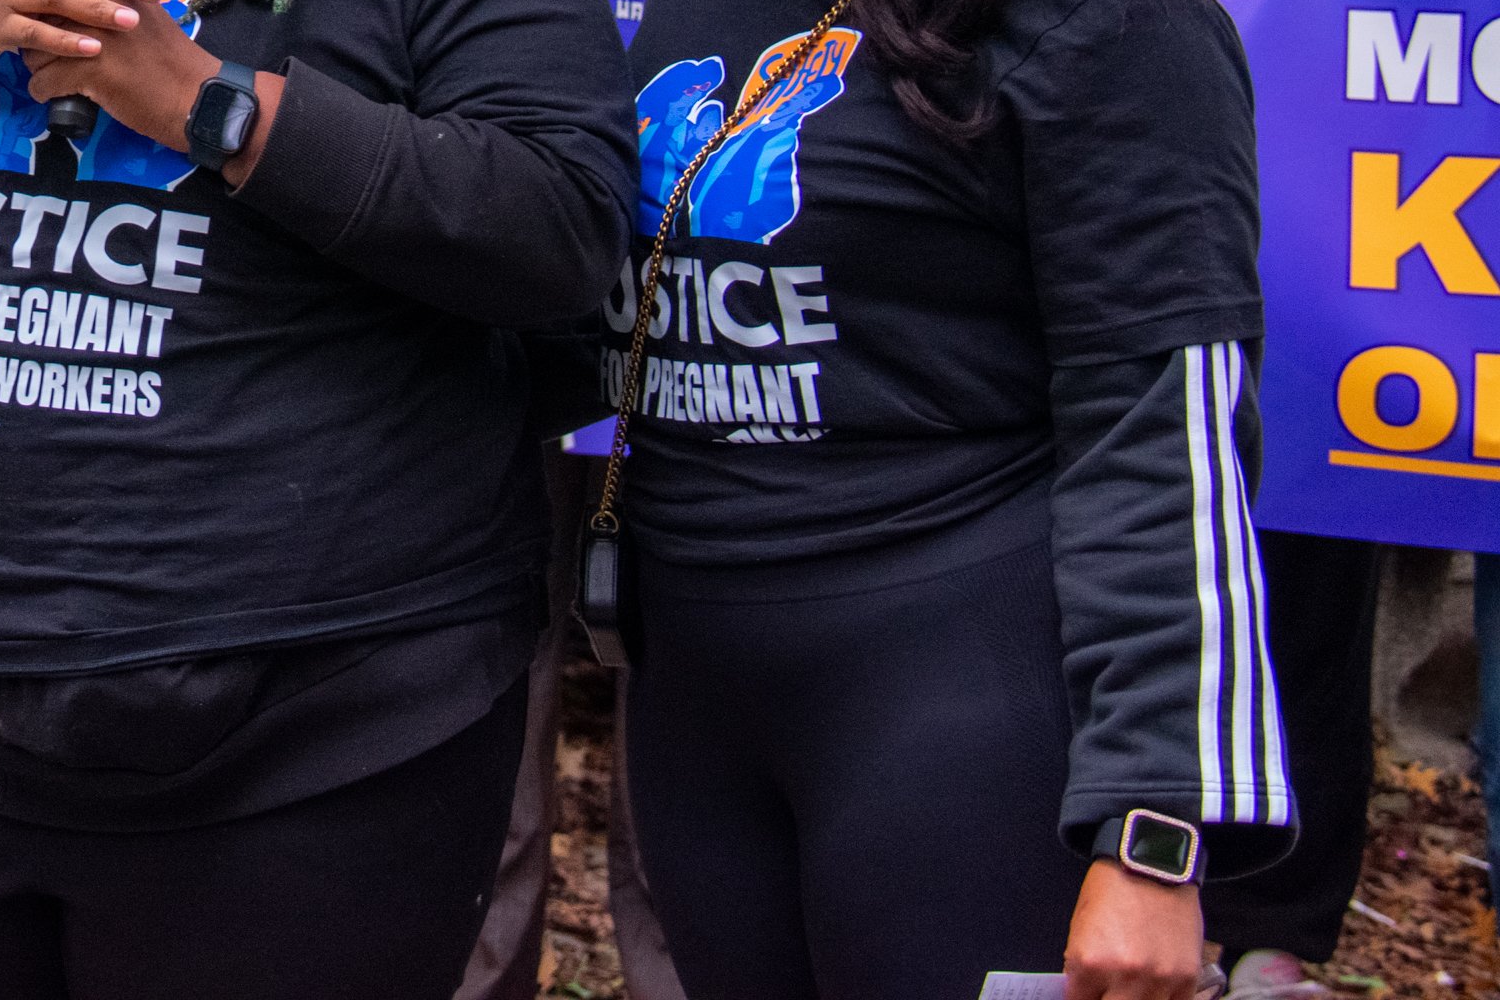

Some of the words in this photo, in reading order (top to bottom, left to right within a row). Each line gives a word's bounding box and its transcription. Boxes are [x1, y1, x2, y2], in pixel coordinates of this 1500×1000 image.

[1346, 9, 1500, 105] M
[602, 255, 838, 348] USTICE
[642, 355, 821, 424] PREGNANT
[1336, 345, 1500, 459] O
